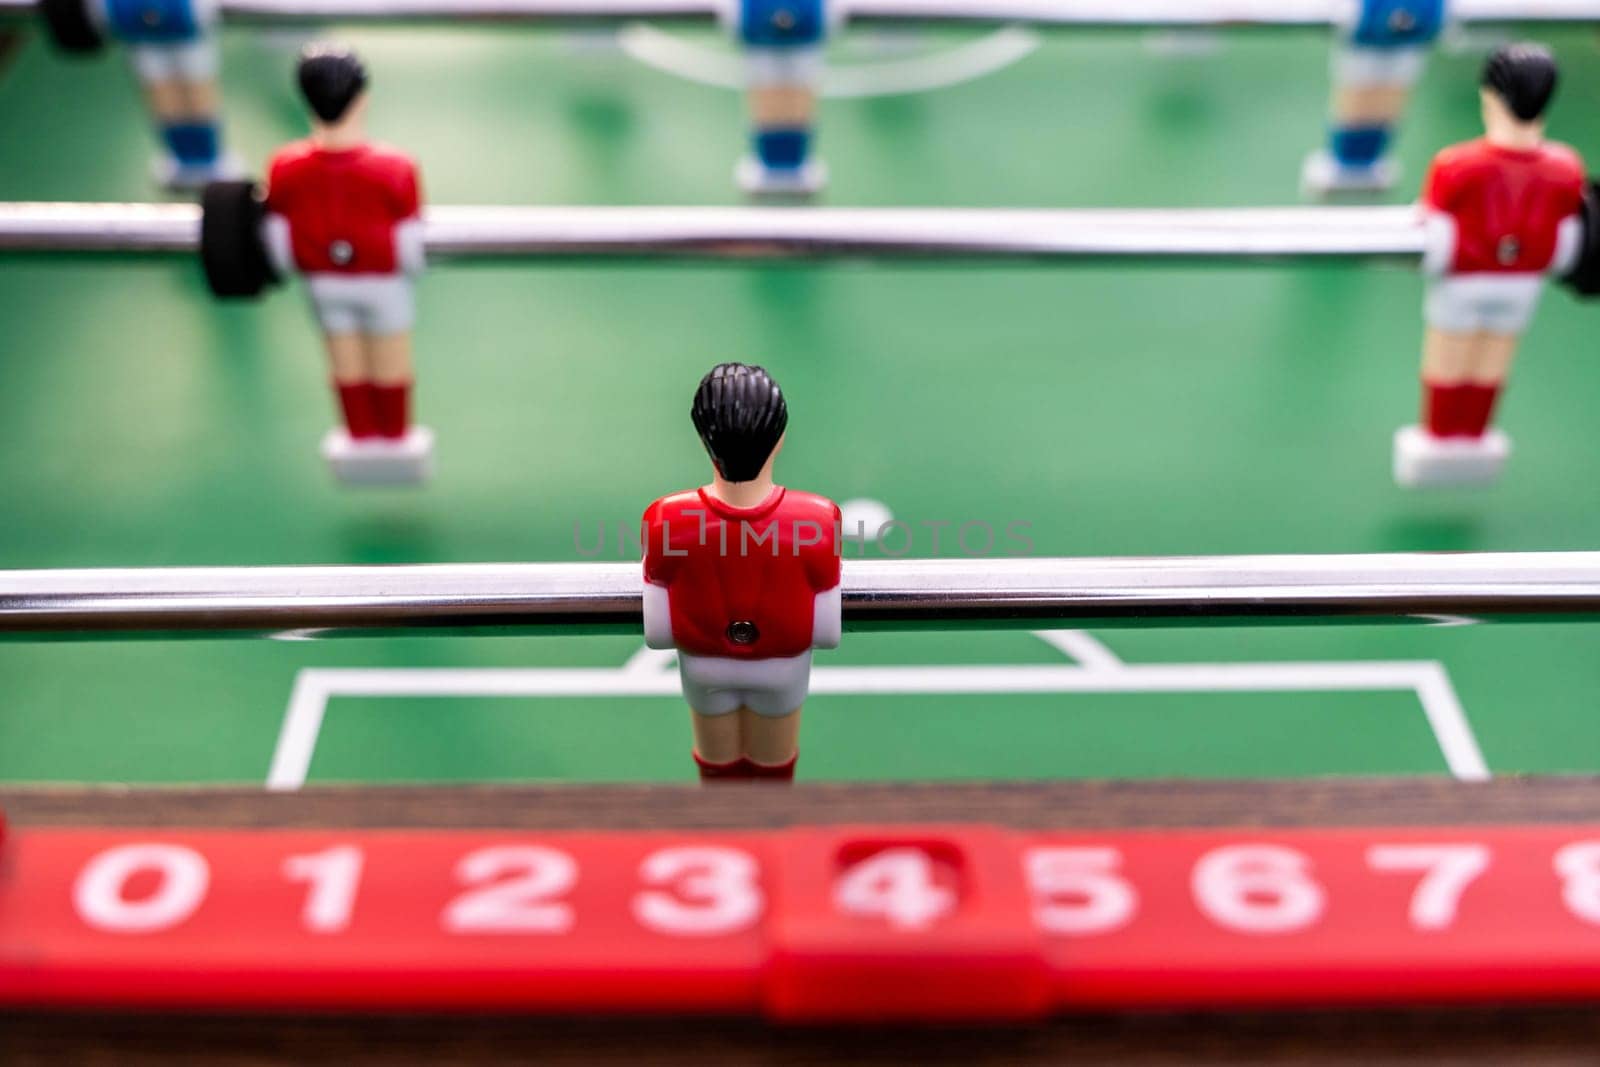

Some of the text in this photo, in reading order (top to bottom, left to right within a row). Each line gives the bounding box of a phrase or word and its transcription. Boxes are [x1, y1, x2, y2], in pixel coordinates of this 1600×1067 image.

[73, 843, 210, 933] 0
[282, 845, 364, 933] 1
[443, 845, 578, 934] 2
[632, 846, 764, 936] 3
[833, 848, 955, 930] 4
[1023, 847, 1138, 935] 5
[1191, 845, 1326, 934] 6
[1367, 844, 1492, 931] 7
